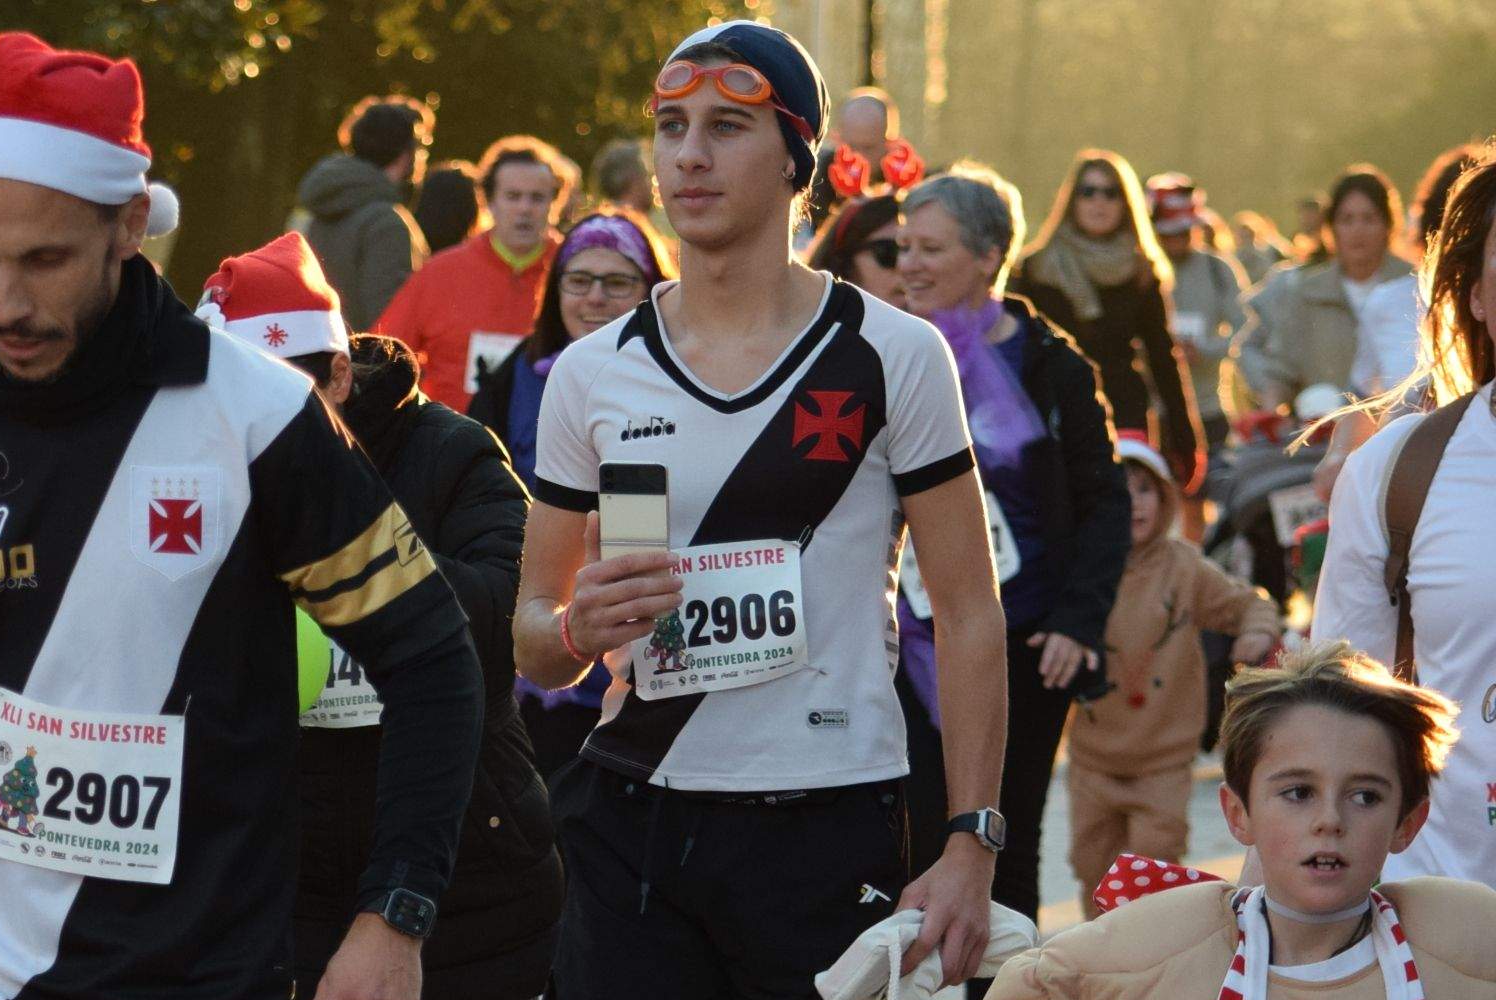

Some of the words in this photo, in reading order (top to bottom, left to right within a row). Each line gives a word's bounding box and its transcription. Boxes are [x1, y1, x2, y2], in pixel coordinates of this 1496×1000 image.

[672, 558, 692, 575] AN
[699, 548, 785, 572] SILVESTRE
[685, 590, 796, 647] 2906
[690, 653, 760, 669] PONTEVEDRA
[765, 647, 793, 660] 2024
[1, 701, 22, 726] XLI
[27, 712, 63, 736] SAN
[69, 721, 166, 745] SILVESTRE
[42, 767, 171, 830] 2907
[39, 830, 120, 853] PONTEVEDRA
[126, 842, 159, 855] 2024
